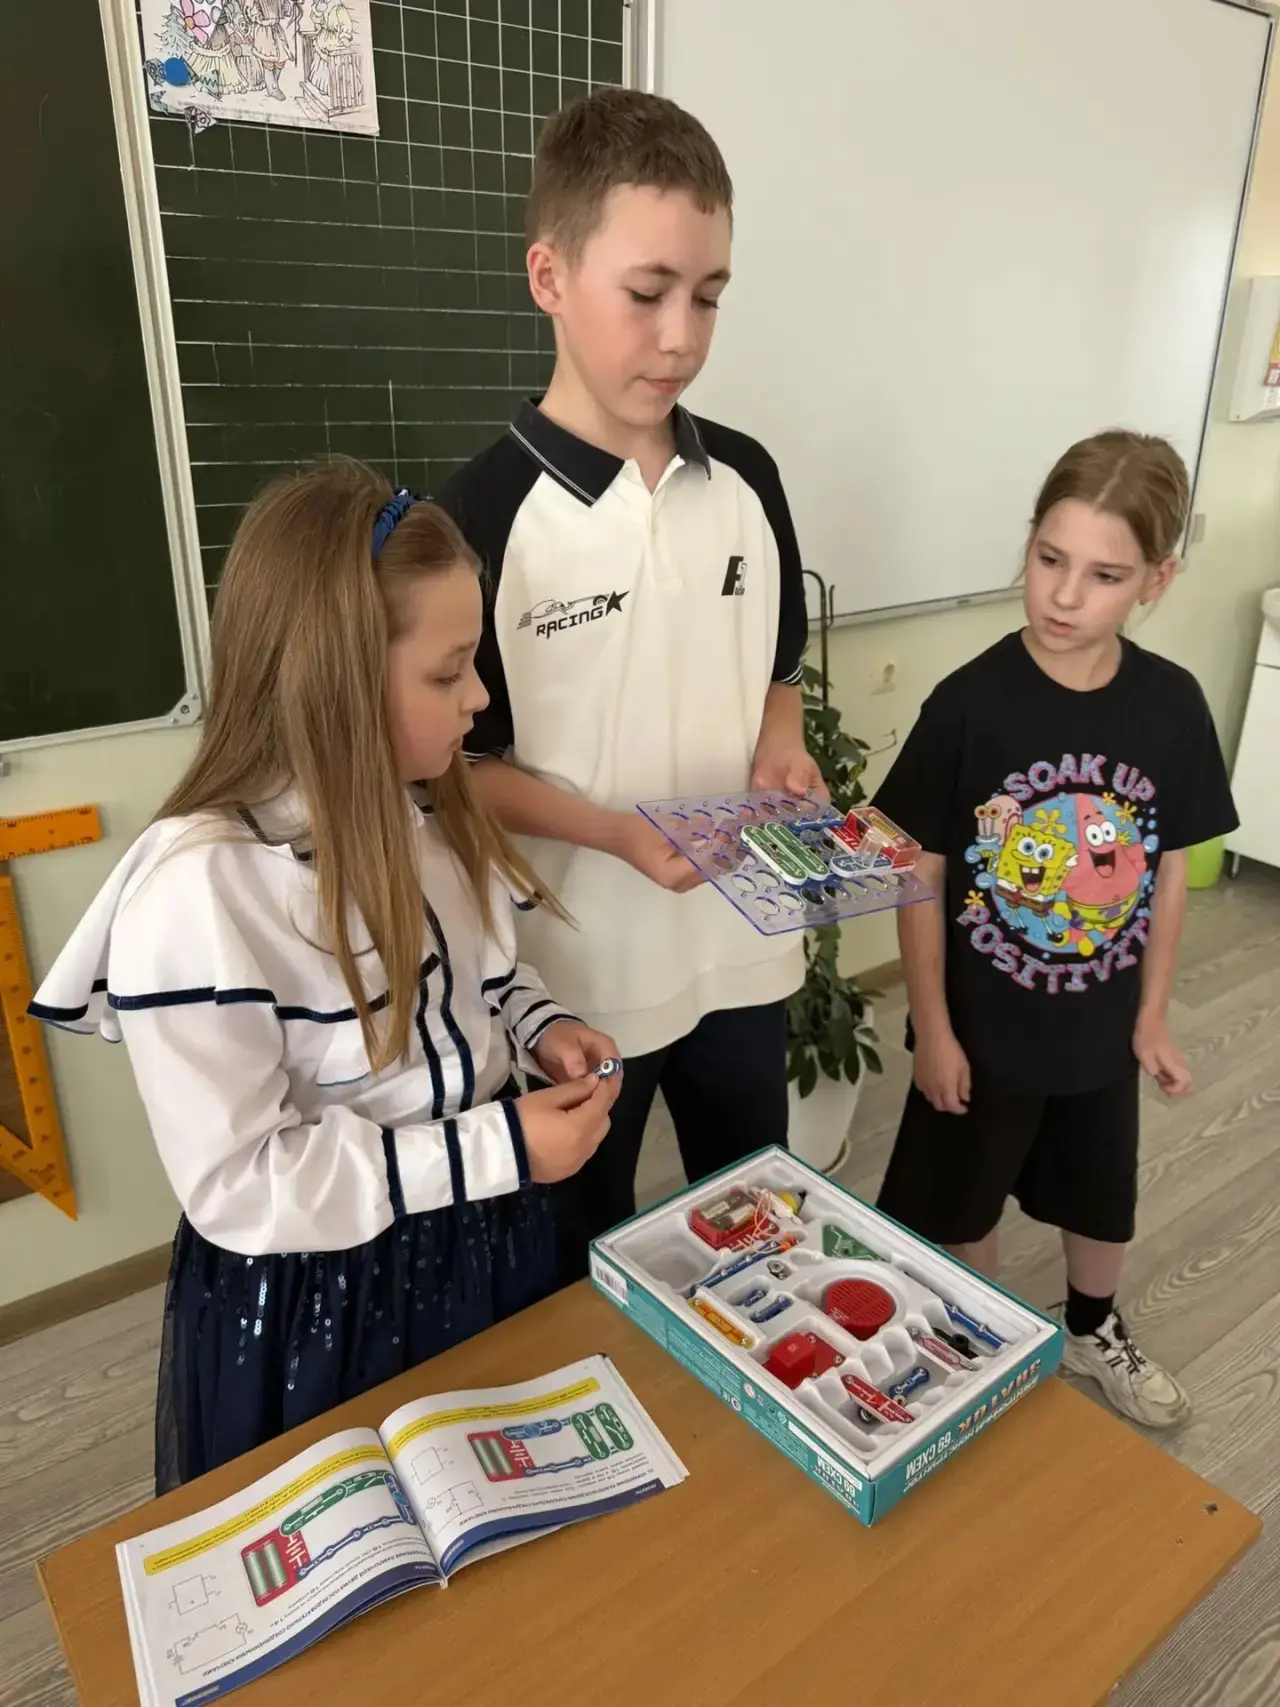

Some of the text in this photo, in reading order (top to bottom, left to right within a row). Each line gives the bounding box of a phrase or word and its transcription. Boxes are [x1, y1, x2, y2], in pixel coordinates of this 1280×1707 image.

[536, 605, 604, 639] RACING
[1003, 753, 1156, 803] SOAK UP
[956, 903, 1149, 994] POSITIVIT
[937, 1430, 952, 1450] 69
[816, 1454, 842, 1484] СХЕМ
[904, 1442, 936, 1480] СХЕМ
[338, 1573, 359, 1591] ДВУМЯ
[357, 1553, 396, 1578] ЛАМПОЧКОЙ
[284, 1587, 340, 1631] ПОСЛЕДОВАТЕЛЬНО
